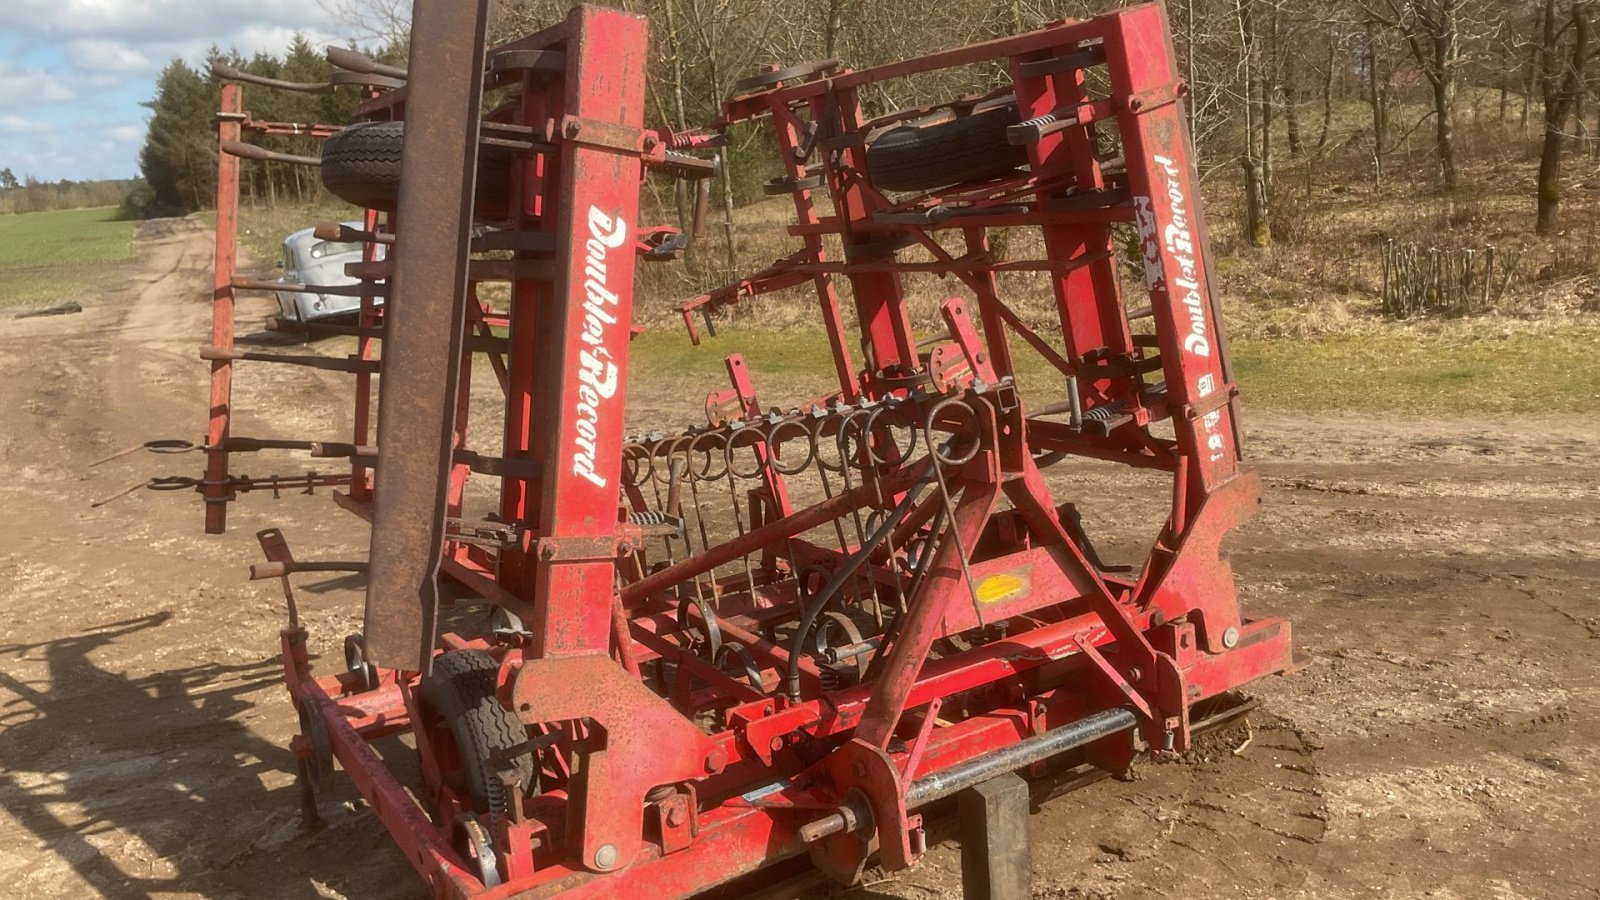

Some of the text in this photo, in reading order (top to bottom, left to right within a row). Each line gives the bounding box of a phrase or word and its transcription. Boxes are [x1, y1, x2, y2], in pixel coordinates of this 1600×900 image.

[1153, 154, 1210, 358] Doublet Record
[572, 346, 619, 488] Record
